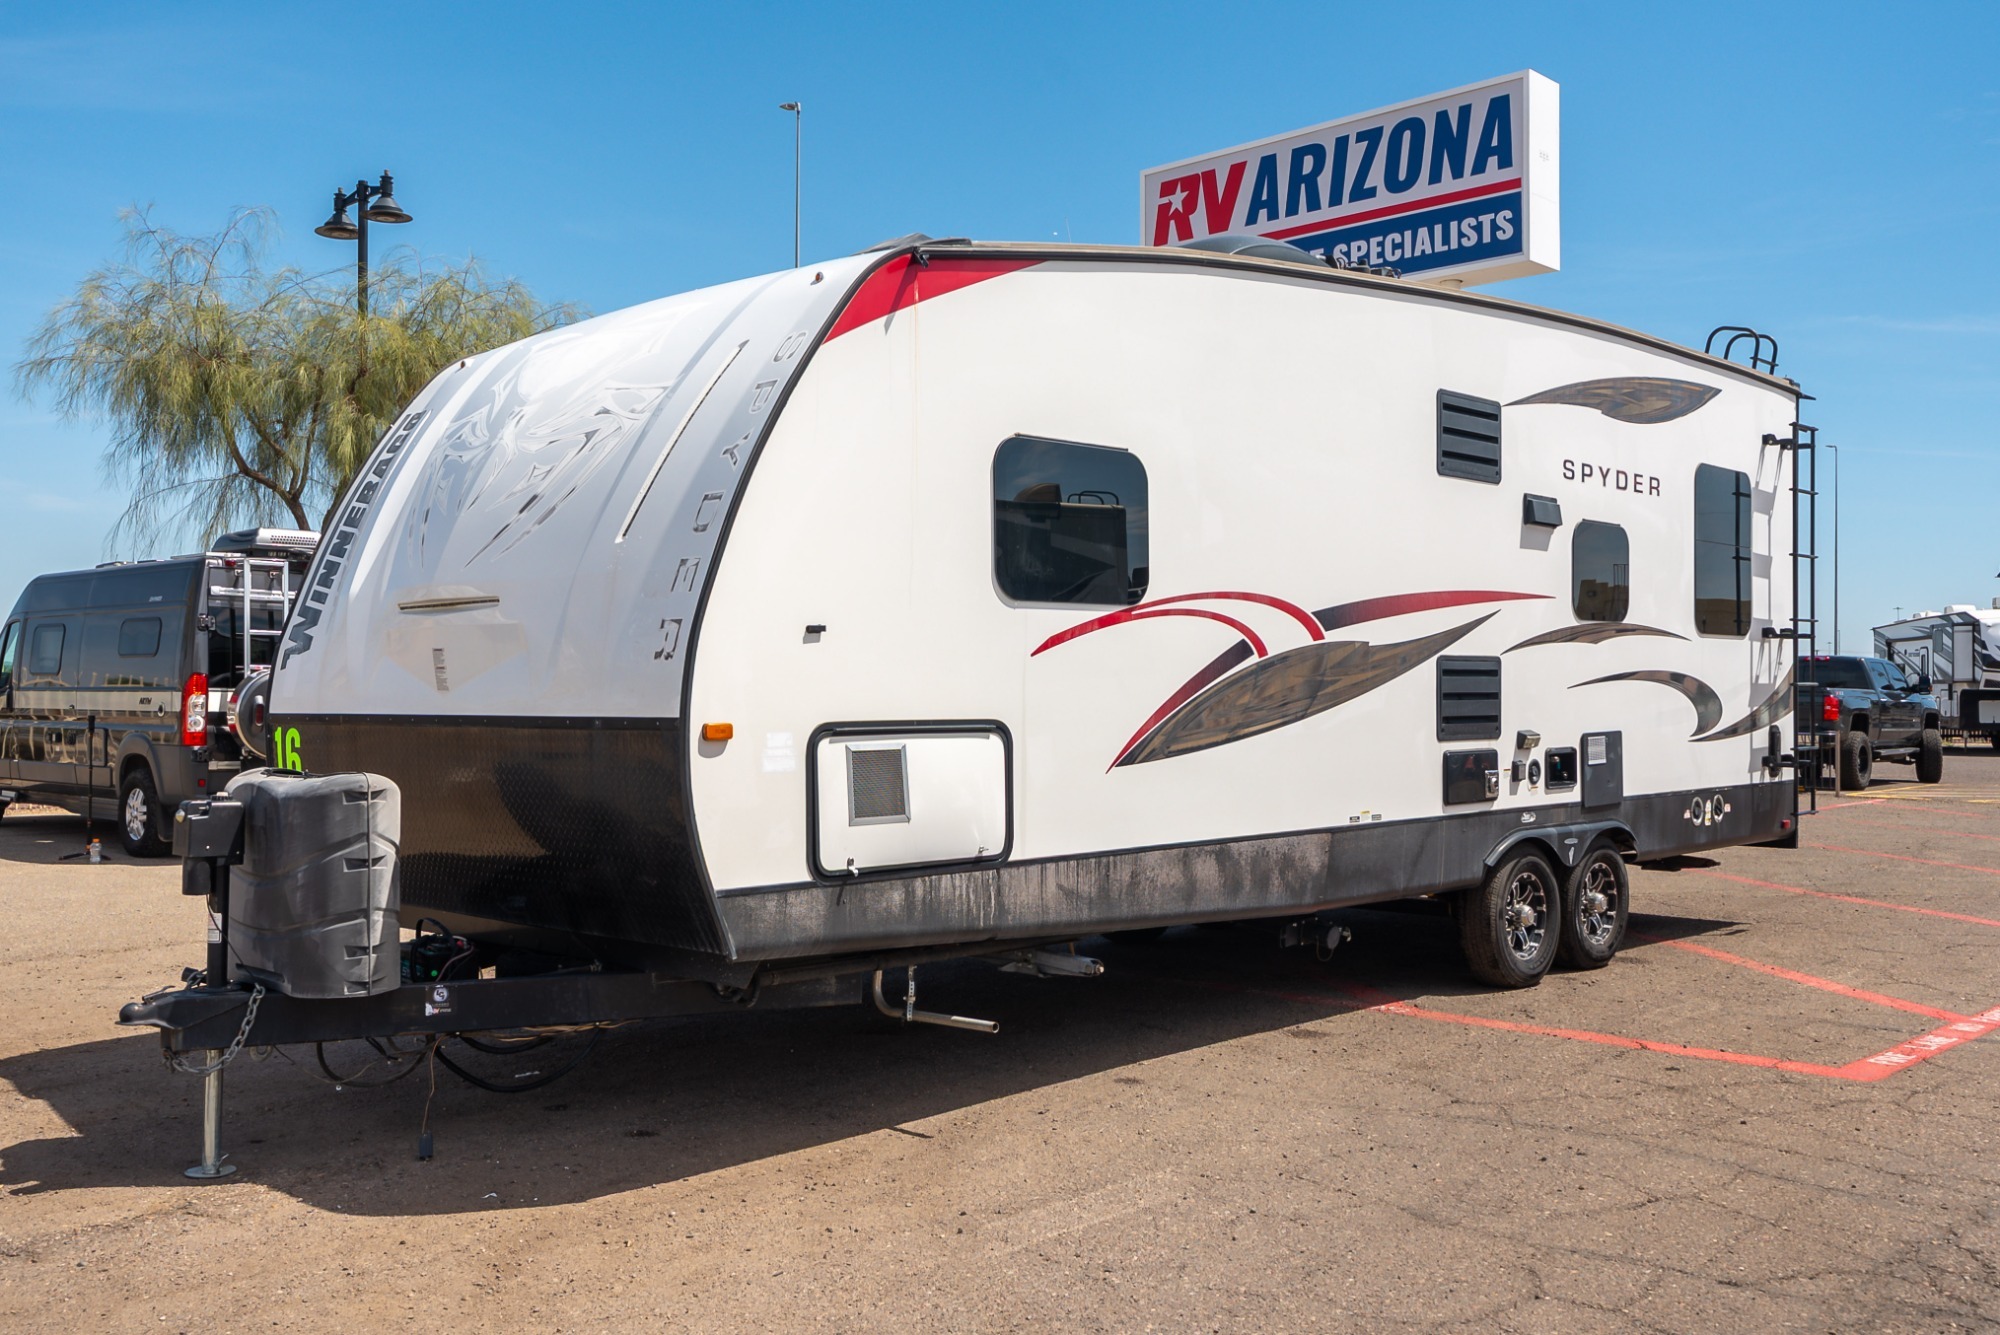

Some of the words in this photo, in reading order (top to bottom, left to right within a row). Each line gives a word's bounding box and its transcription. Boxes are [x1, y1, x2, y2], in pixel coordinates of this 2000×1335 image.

[1154, 160, 1248, 247] RV
[1245, 94, 1514, 226] ARIZONA
[1333, 209, 1514, 269] SPECIALISTS
[653, 331, 806, 662] SPYDER
[1562, 459, 1662, 497] SPYDER
[280, 409, 428, 671] WINNEBAGO
[274, 726, 302, 772] 16
